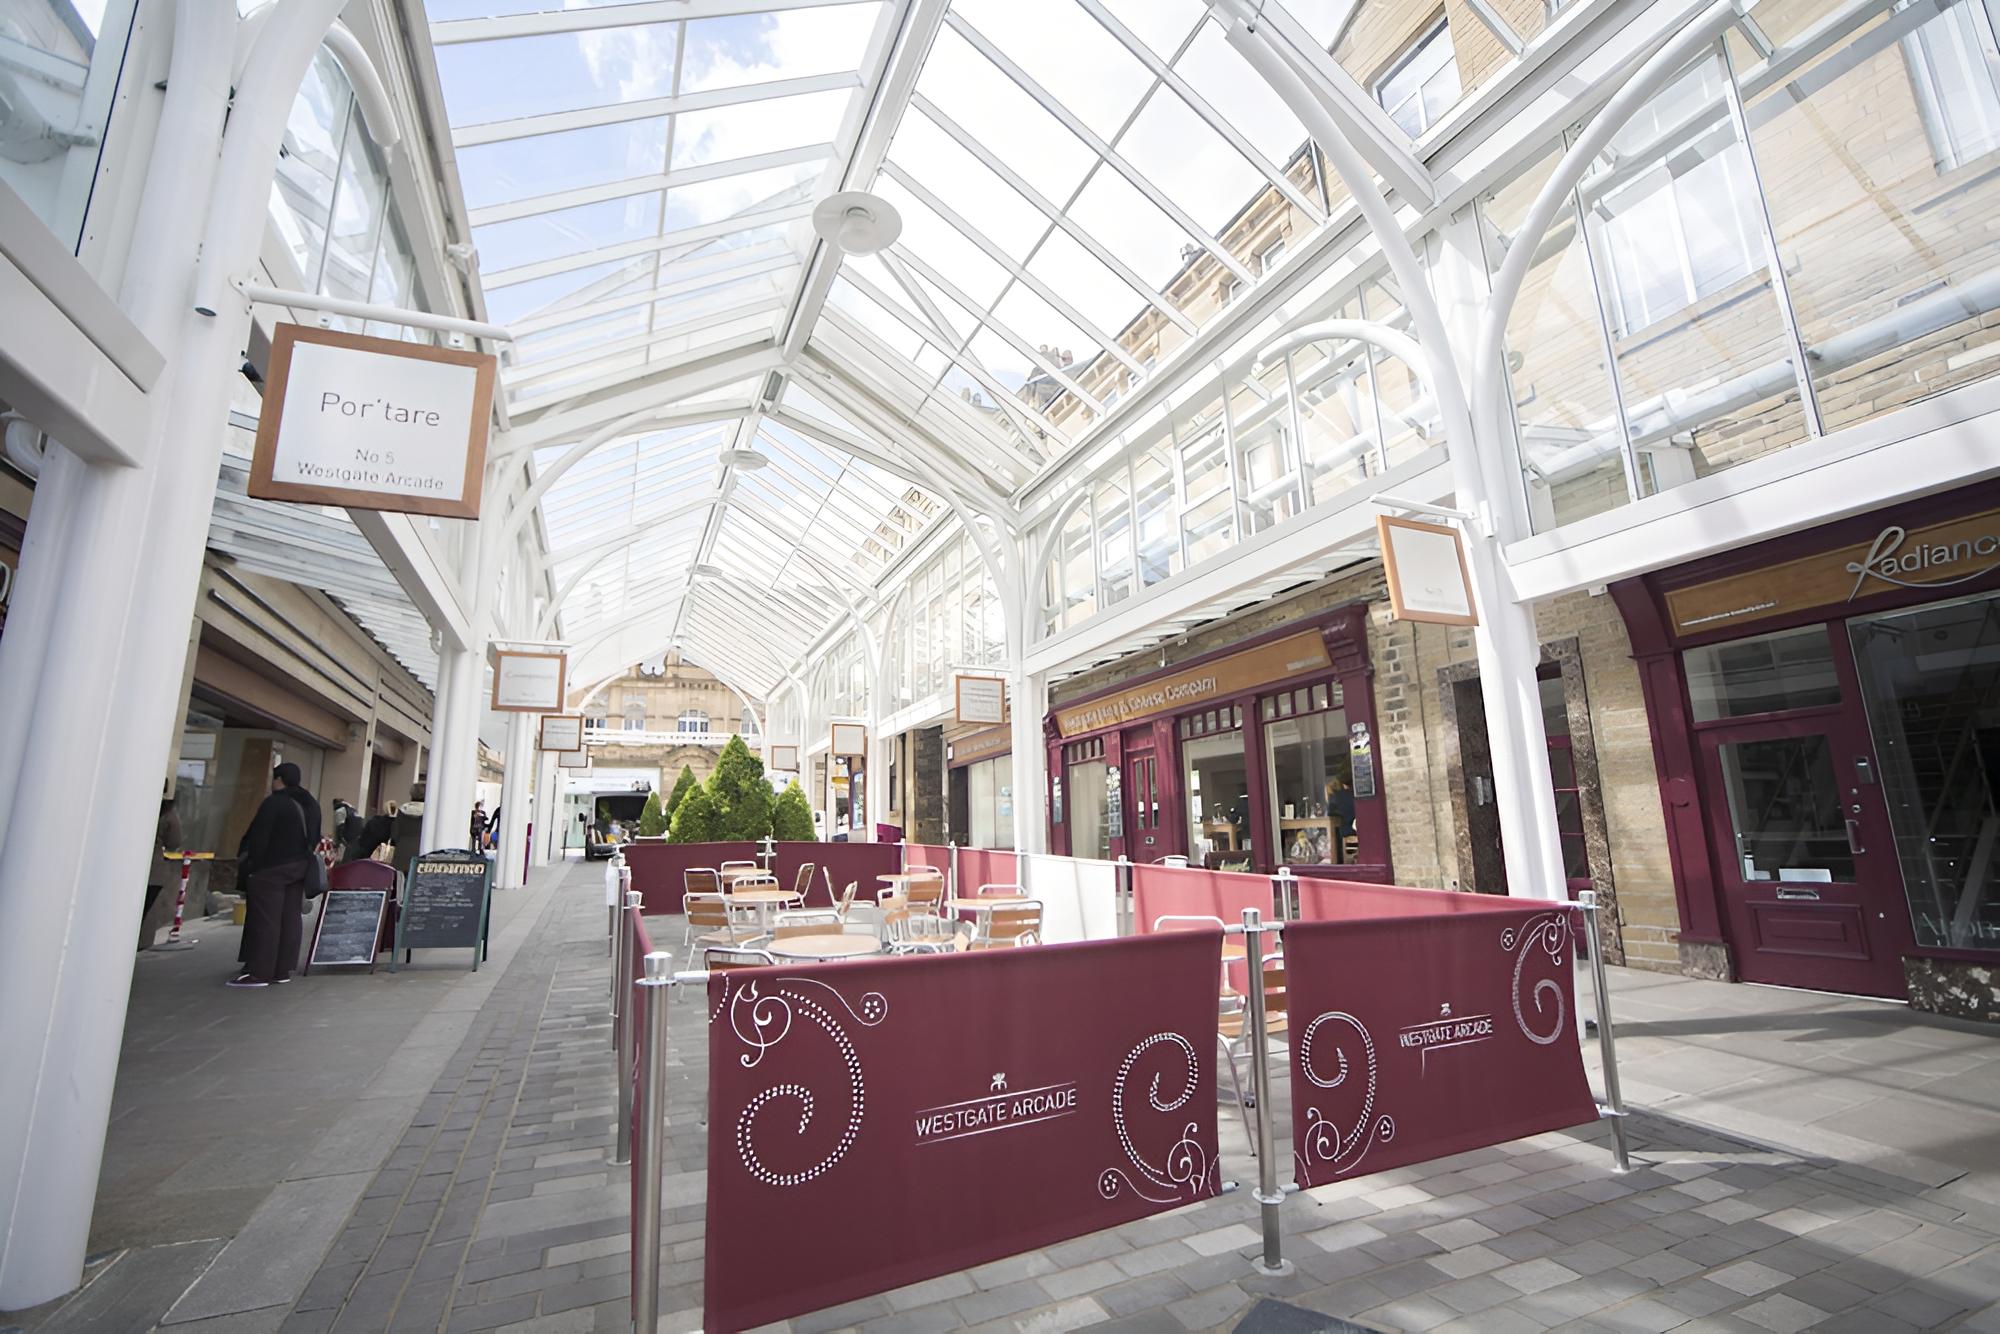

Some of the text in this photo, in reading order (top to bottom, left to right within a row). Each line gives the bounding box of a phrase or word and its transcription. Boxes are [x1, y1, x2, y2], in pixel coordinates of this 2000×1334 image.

[320, 391, 440, 427] Por'tare
[298, 461, 443, 490] Westgate Arcade
[1846, 526, 2000, 602] Radianc
[915, 1088, 1077, 1137] WESTGATE ARCADE
